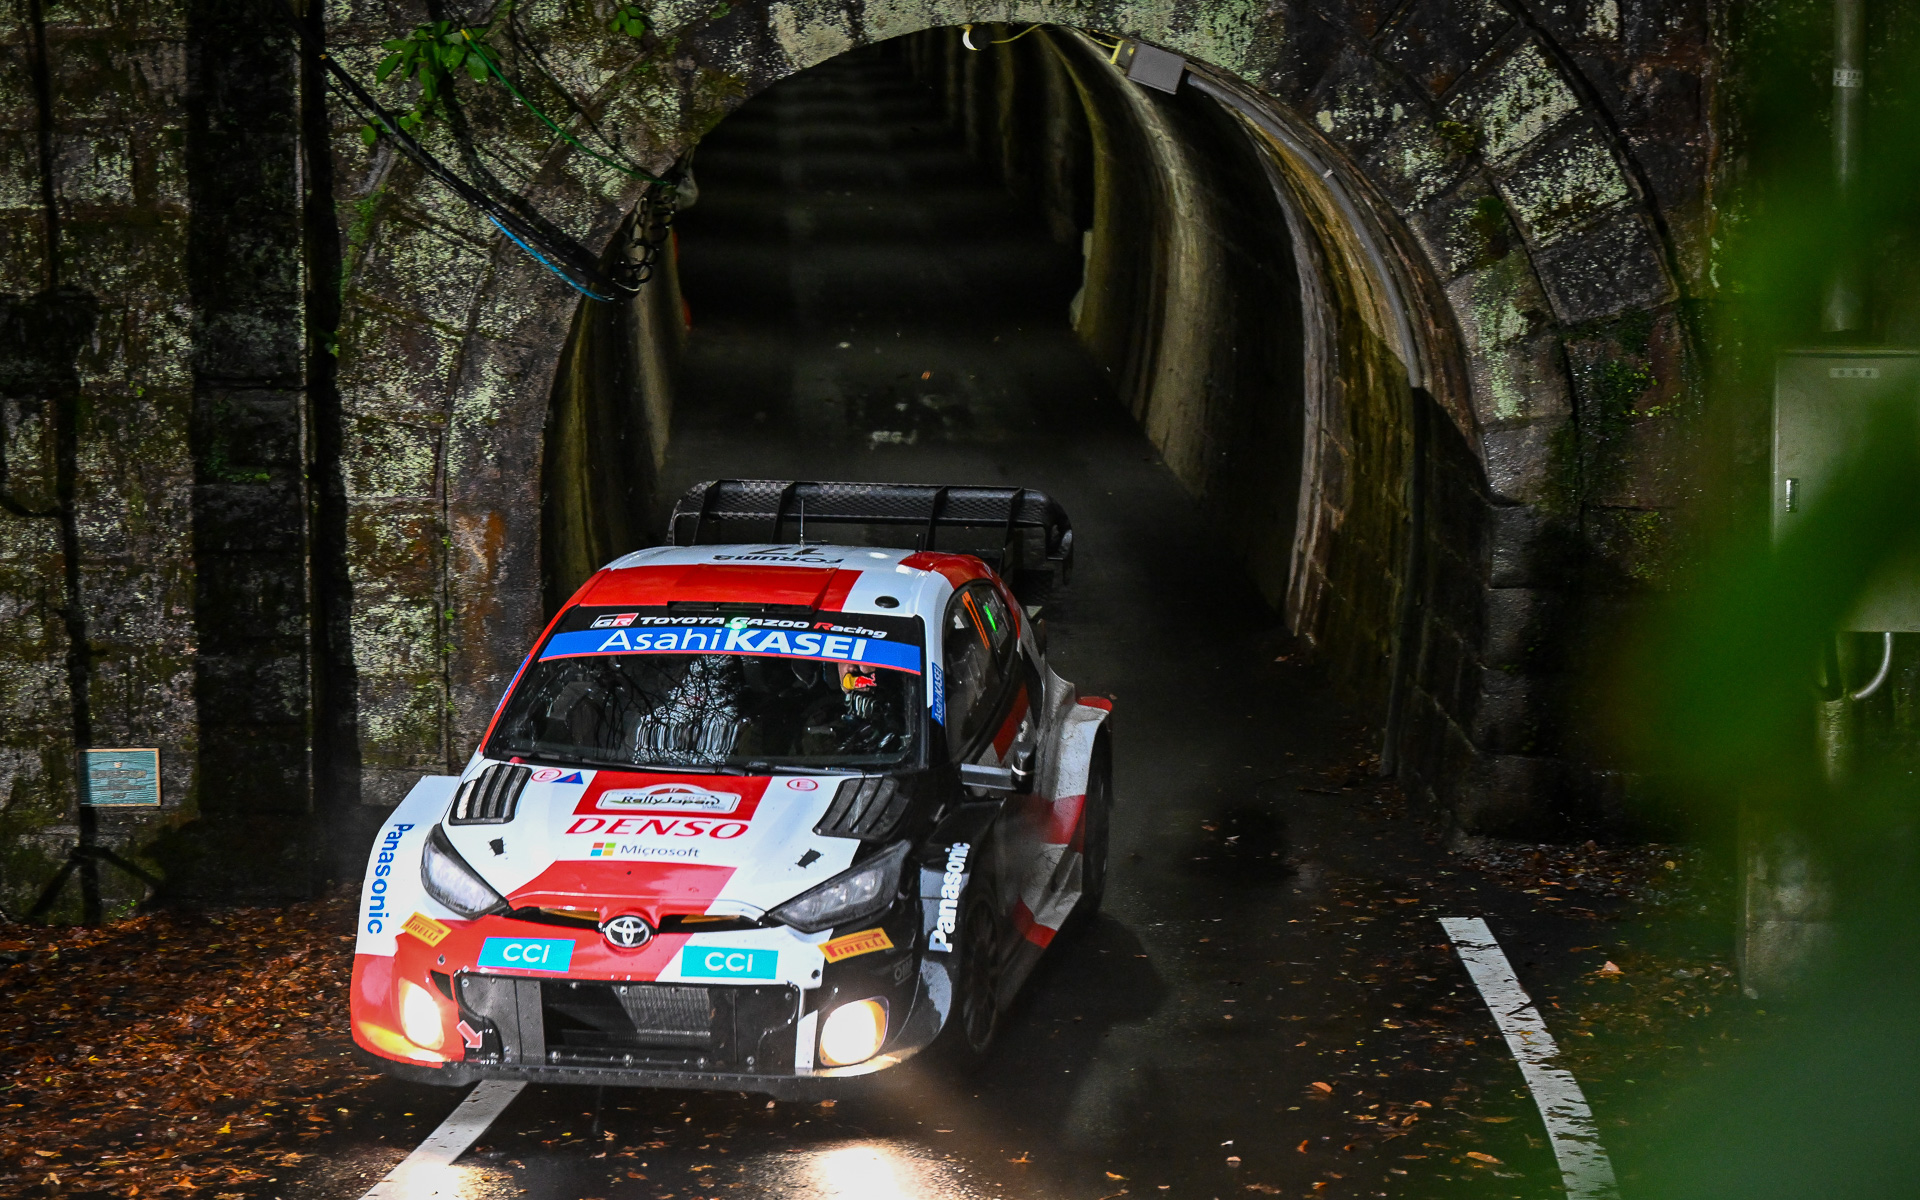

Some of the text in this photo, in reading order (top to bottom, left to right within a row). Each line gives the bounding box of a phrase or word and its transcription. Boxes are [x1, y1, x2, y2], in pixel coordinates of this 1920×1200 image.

[596, 616, 888, 639] GR TOYOTA GAZOO Racing
[565, 818, 749, 839] DENSO
[620, 844, 700, 858] Microsoft
[367, 823, 416, 934] Panasonic
[928, 842, 971, 953] Panasonic
[405, 915, 445, 942] PIRELLI
[502, 943, 551, 964] CCI
[825, 932, 888, 957] PIRELLI
[704, 951, 754, 973] CCI
